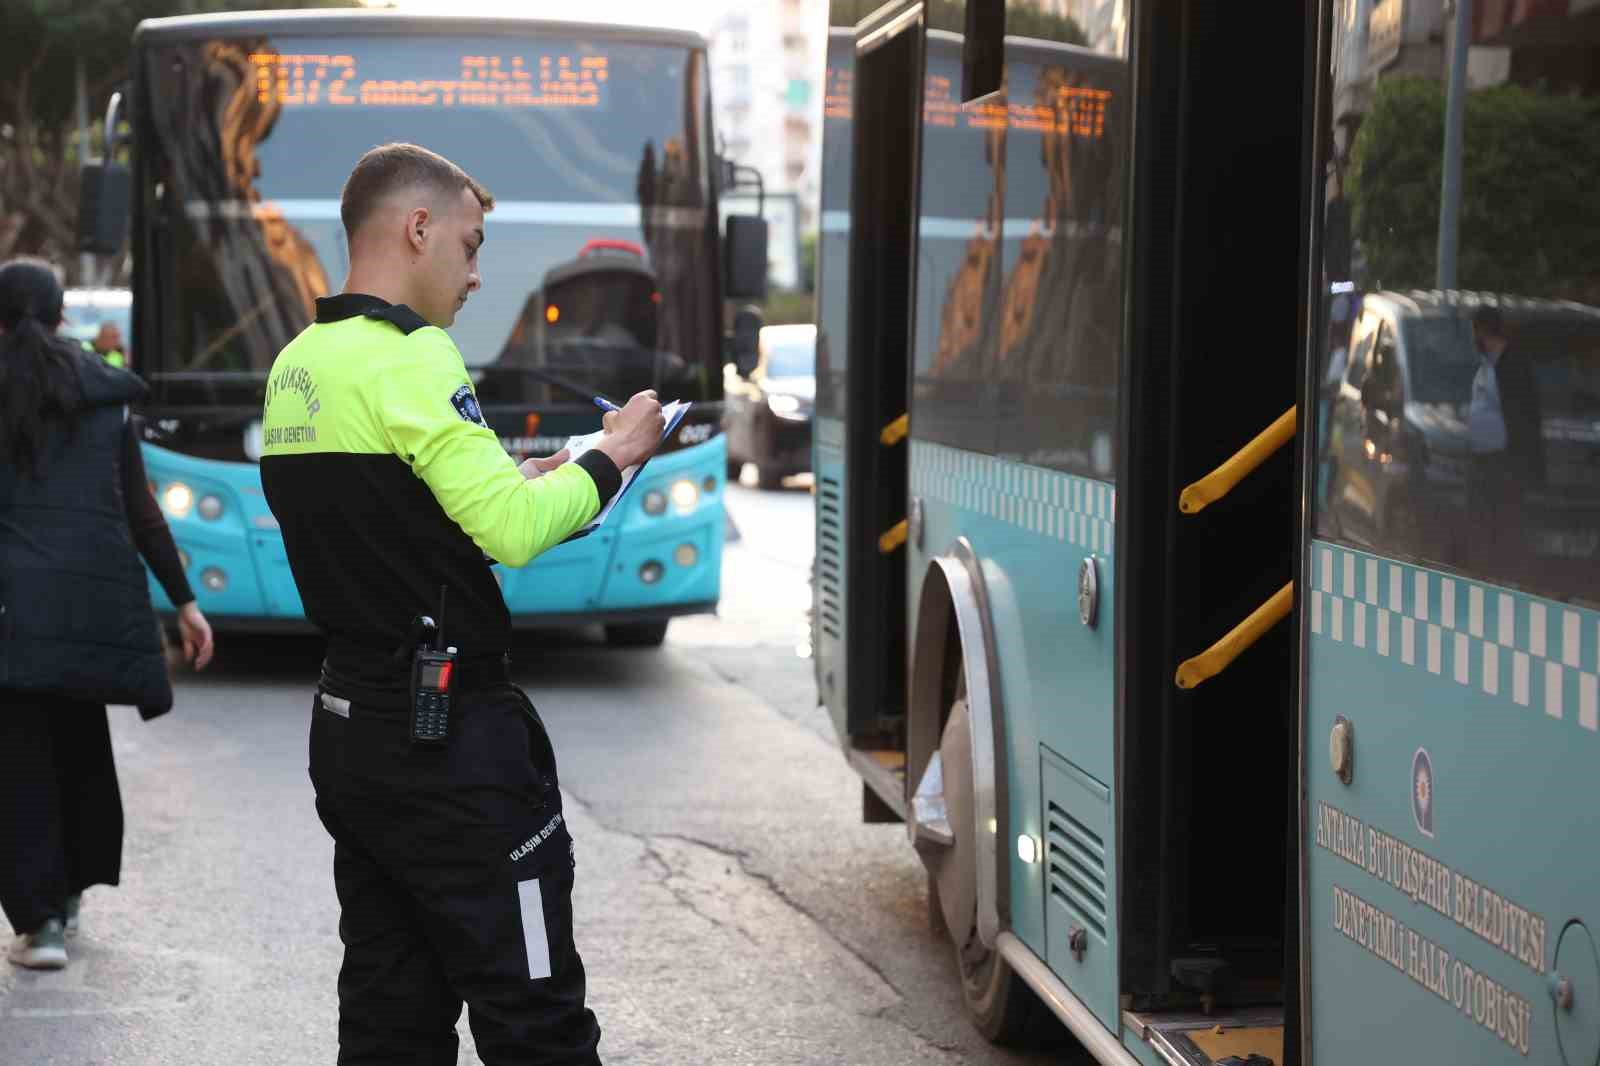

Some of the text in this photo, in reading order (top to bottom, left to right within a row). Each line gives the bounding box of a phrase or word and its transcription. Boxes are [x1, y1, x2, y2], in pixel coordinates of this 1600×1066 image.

[509, 834, 542, 861] ULAŞIM
[1316, 801, 1546, 974] ANTALYA BÜYÜKŞEHİR BELEDİYESİ
[1333, 885, 1531, 1056] DENETİMLİ HALK OTOBÜSÜ
